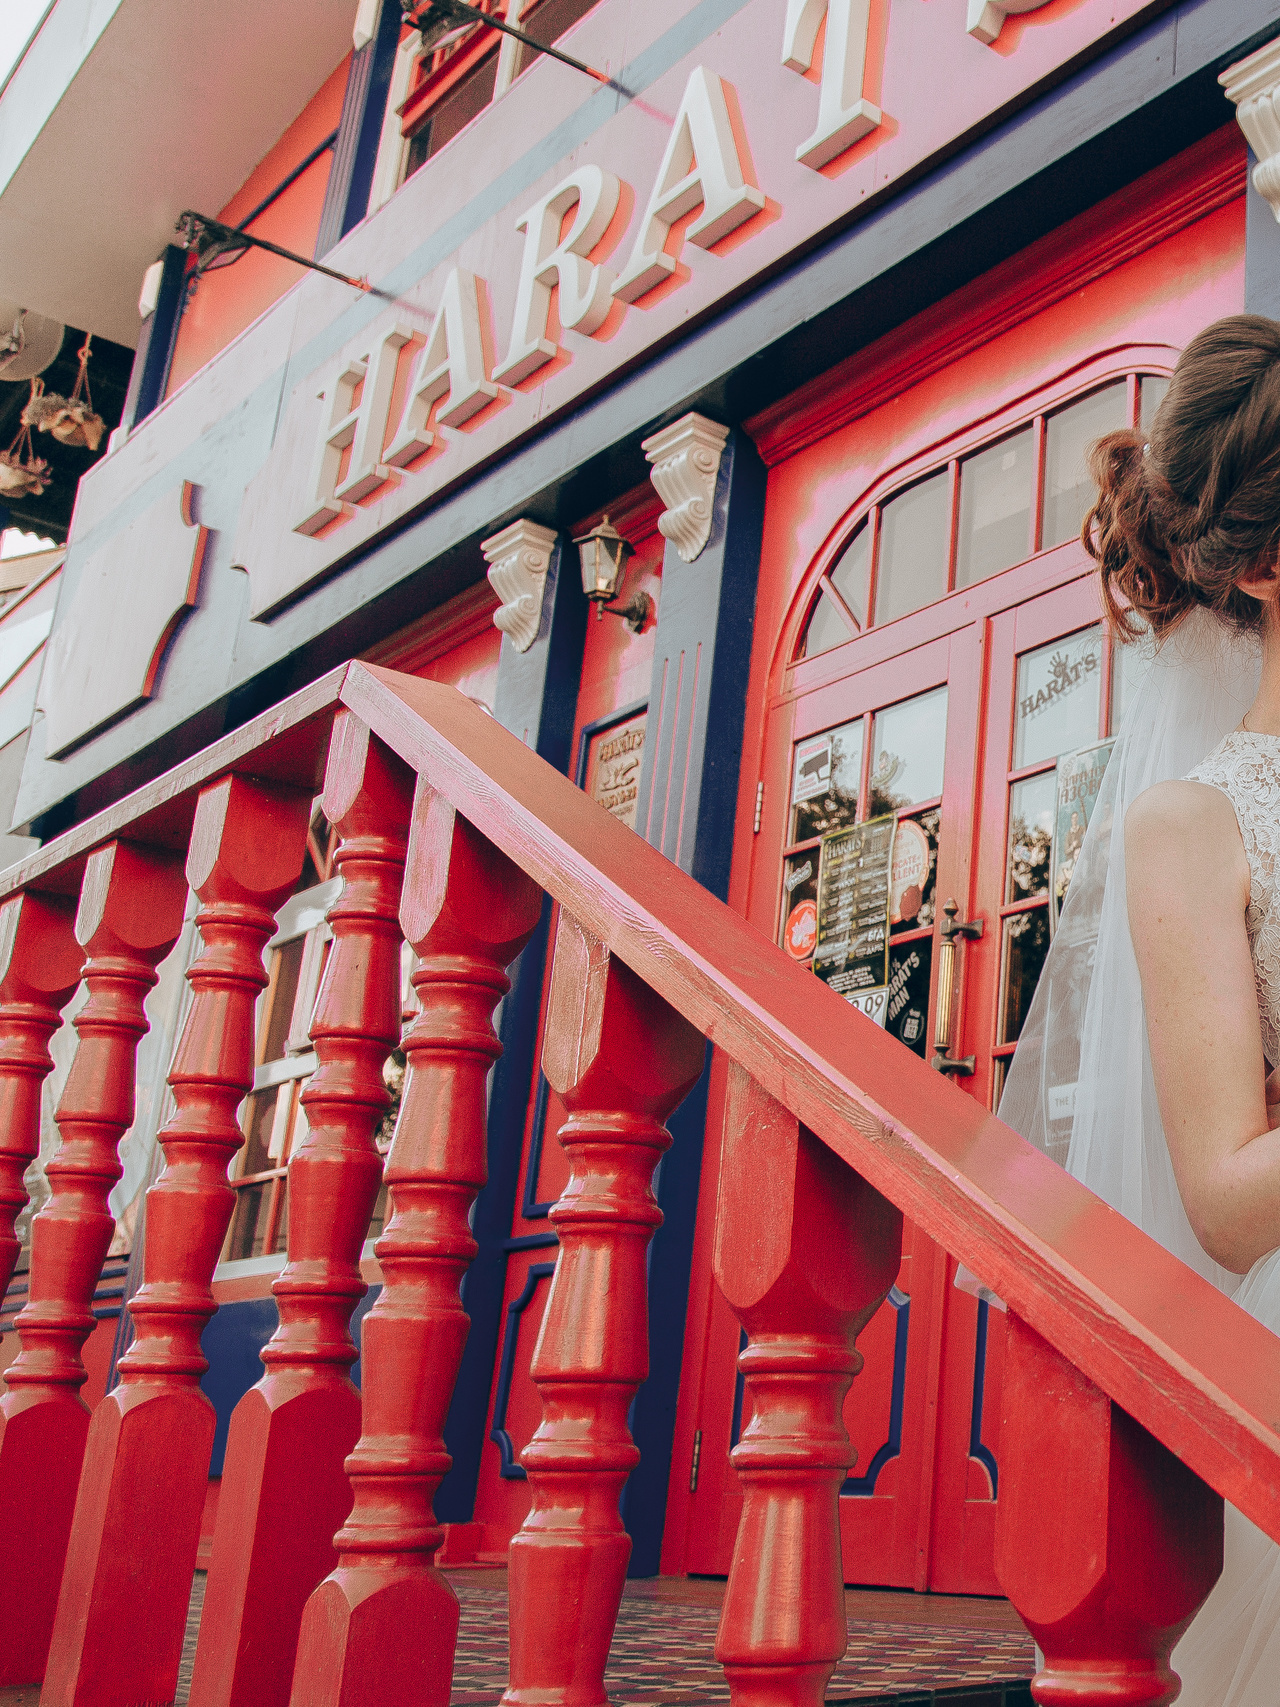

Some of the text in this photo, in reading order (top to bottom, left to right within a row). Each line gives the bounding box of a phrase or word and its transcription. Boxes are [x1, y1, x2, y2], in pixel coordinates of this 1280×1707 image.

[292, 0, 1050, 540] HARAT
[1020, 652, 1097, 719] HARAT'S
[888, 951, 920, 999] ARAT'S
[888, 986, 910, 1021] MAN
